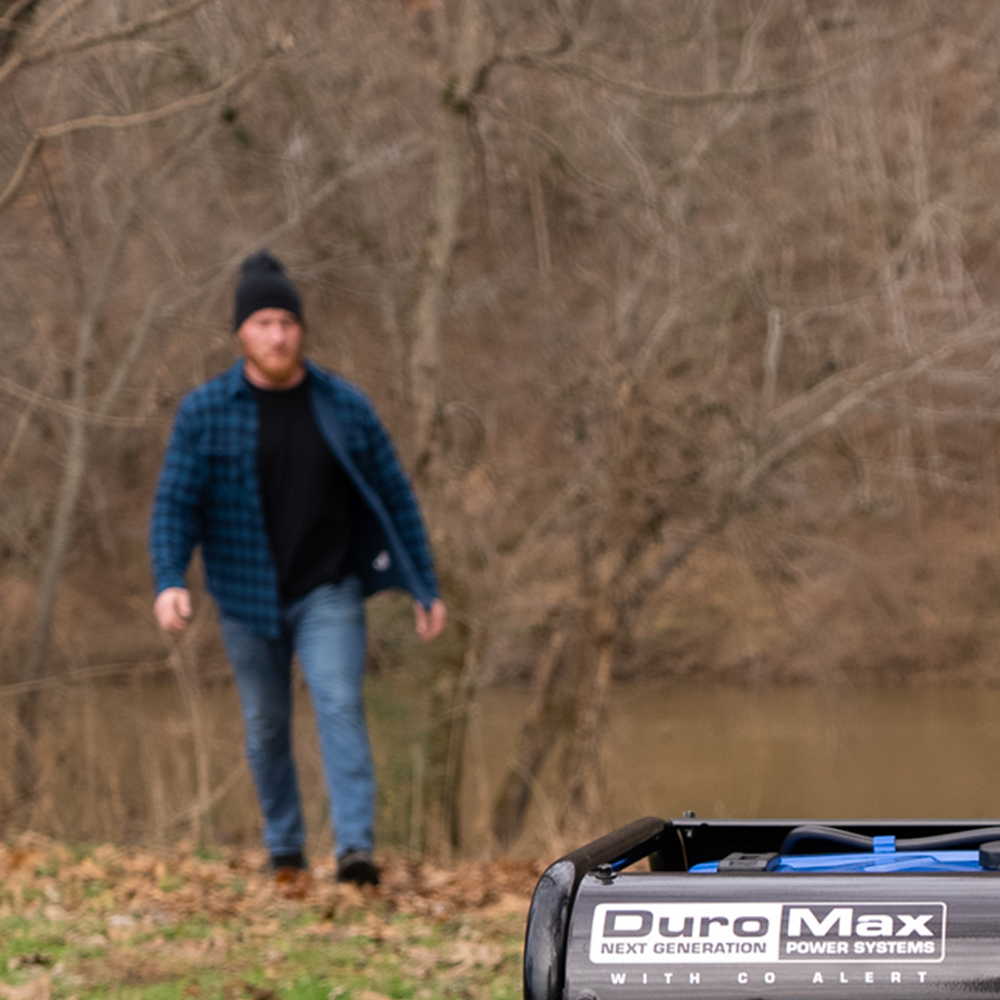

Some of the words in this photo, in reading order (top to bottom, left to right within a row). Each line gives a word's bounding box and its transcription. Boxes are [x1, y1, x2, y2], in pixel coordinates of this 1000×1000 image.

[602, 909, 770, 938] Duro
[787, 908, 934, 937] Max
[601, 942, 649, 955] NEXT
[653, 942, 766, 954] GENERATION
[786, 941, 849, 954] POWER
[853, 941, 935, 954] SYSTEMS
[610, 972, 701, 985] WITH
[737, 972, 776, 984] CO
[813, 971, 928, 984] ALERT
